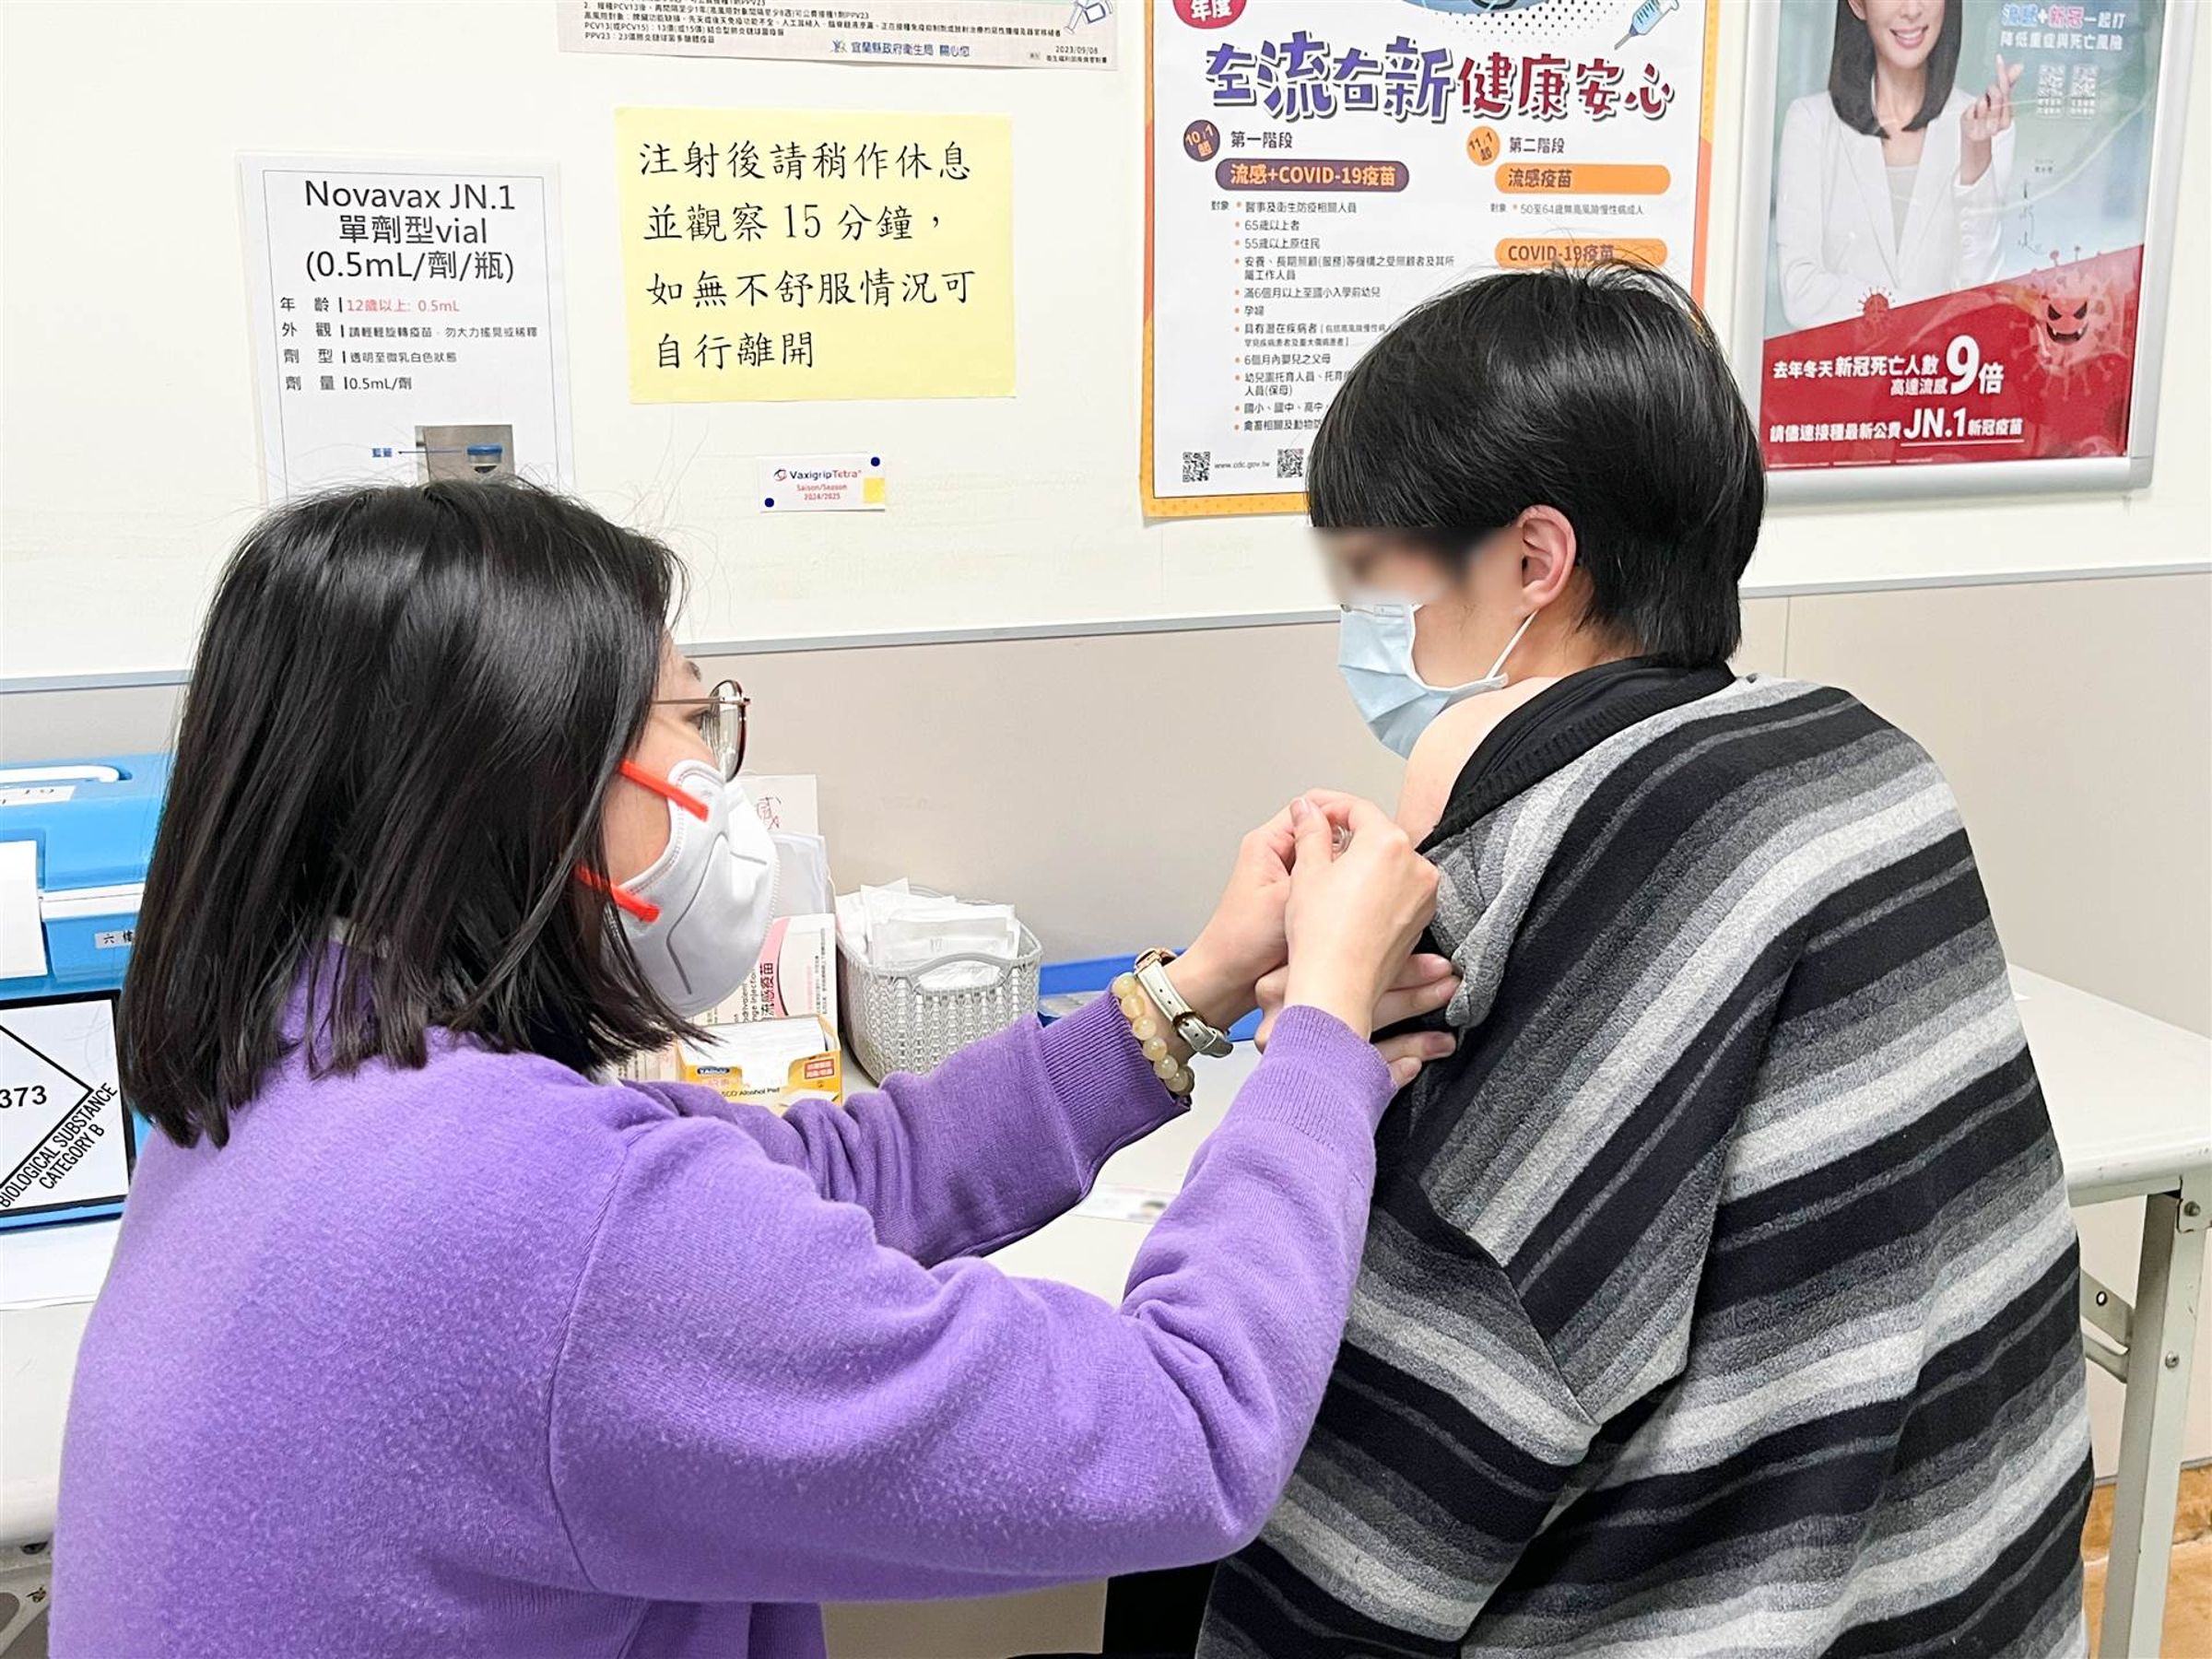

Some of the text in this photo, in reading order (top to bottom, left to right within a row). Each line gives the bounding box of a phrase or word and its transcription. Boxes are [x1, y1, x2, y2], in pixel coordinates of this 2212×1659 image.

[1191, 0, 1232, 22] 年度
[1230, 131, 1293, 148] 第一階段
[1509, 136, 1565, 154] 第二階段
[639, 140, 971, 181] 注射後請稍作休息
[1230, 163, 1396, 186] 流感+COVID-19疫苗
[1508, 168, 1572, 188] 流感疫苗
[305, 180, 516, 210] Novavax JN.1
[1211, 200, 1357, 214] 對象 醫事及衛生防疫相關人員
[339, 214, 488, 245] 單劑型vial
[1244, 219, 1300, 230] 65歲以上者
[1244, 237, 1321, 250] 55歲以上原住民
[1508, 243, 1615, 263] COVID-19疫苗
[306, 250, 515, 283] (0.5mL/劑/瓶)
[645, 266, 976, 308] 如無不舒服情況可
[418, 300, 461, 312] 0.5mL
[1244, 305, 1265, 316] 孕婦
[349, 352, 457, 364] 透明至微乳白色狀態
[657, 331, 814, 370] 自行離開
[1773, 354, 1939, 379] 去年冬天新冠死亡人數
[1244, 384, 1293, 396] 人員(保母)
[1890, 377, 1948, 396] 高達流感
[1214, 461, 1270, 469] www.cdc.gov.tw
[0, 1082, 119, 1208] BIOLOGICAL SUBSTANCE
[39, 1124, 105, 1190] CATEGORY B
